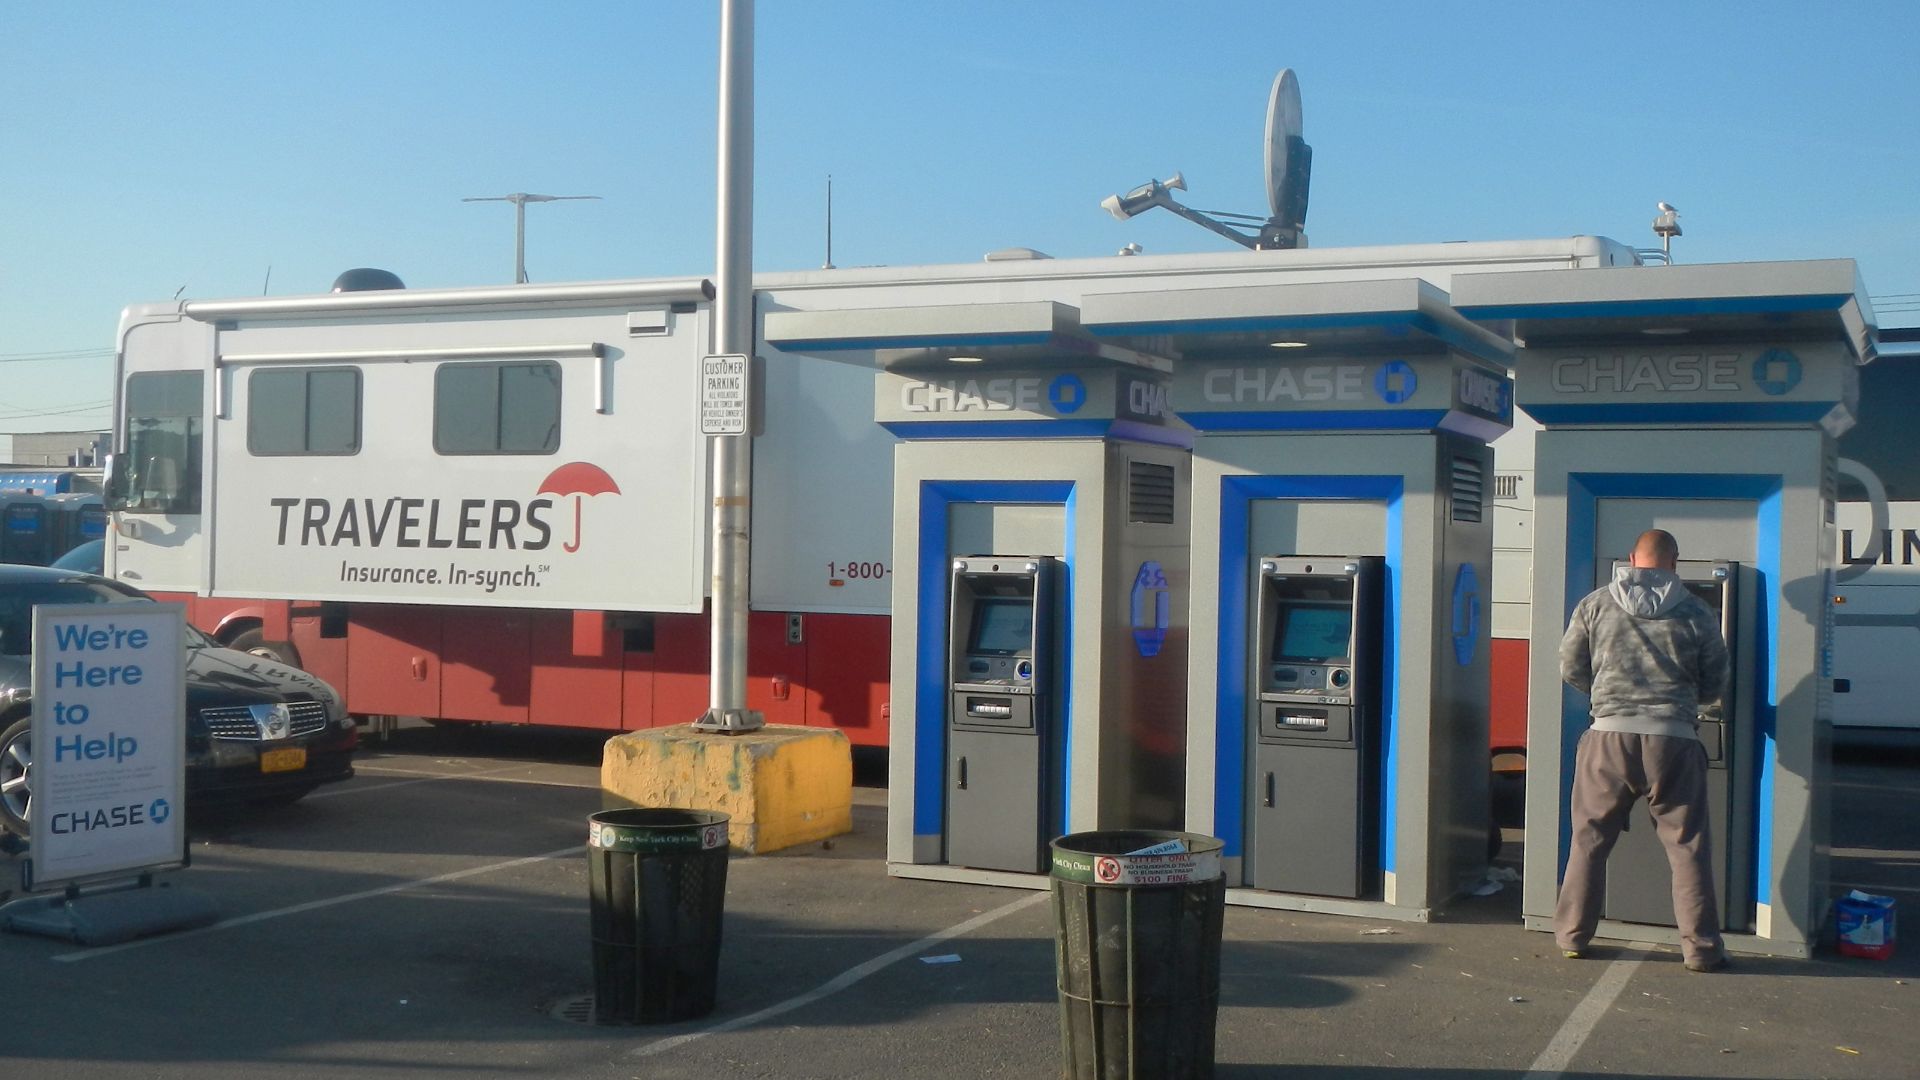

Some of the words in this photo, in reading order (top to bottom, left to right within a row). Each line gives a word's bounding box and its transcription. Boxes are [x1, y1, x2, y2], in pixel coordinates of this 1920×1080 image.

[705, 362, 743, 375] CUSTOMER
[1551, 353, 1741, 393] CHASE
[708, 377, 739, 389] PARKING
[901, 378, 1042, 412] CHASE
[1203, 365, 1366, 403] CHASE
[270, 496, 553, 551] TRAVELERS
[340, 560, 442, 585] Insurance.
[828, 561, 892, 580] 1-800-
[54, 623, 149, 652] We're
[56, 661, 143, 689] Here
[54, 701, 90, 726] to
[56, 731, 138, 764] Help
[51, 804, 145, 835] CHASE
[1168, 854, 1192, 862] ONLY
[1167, 874, 1190, 882] FINE
